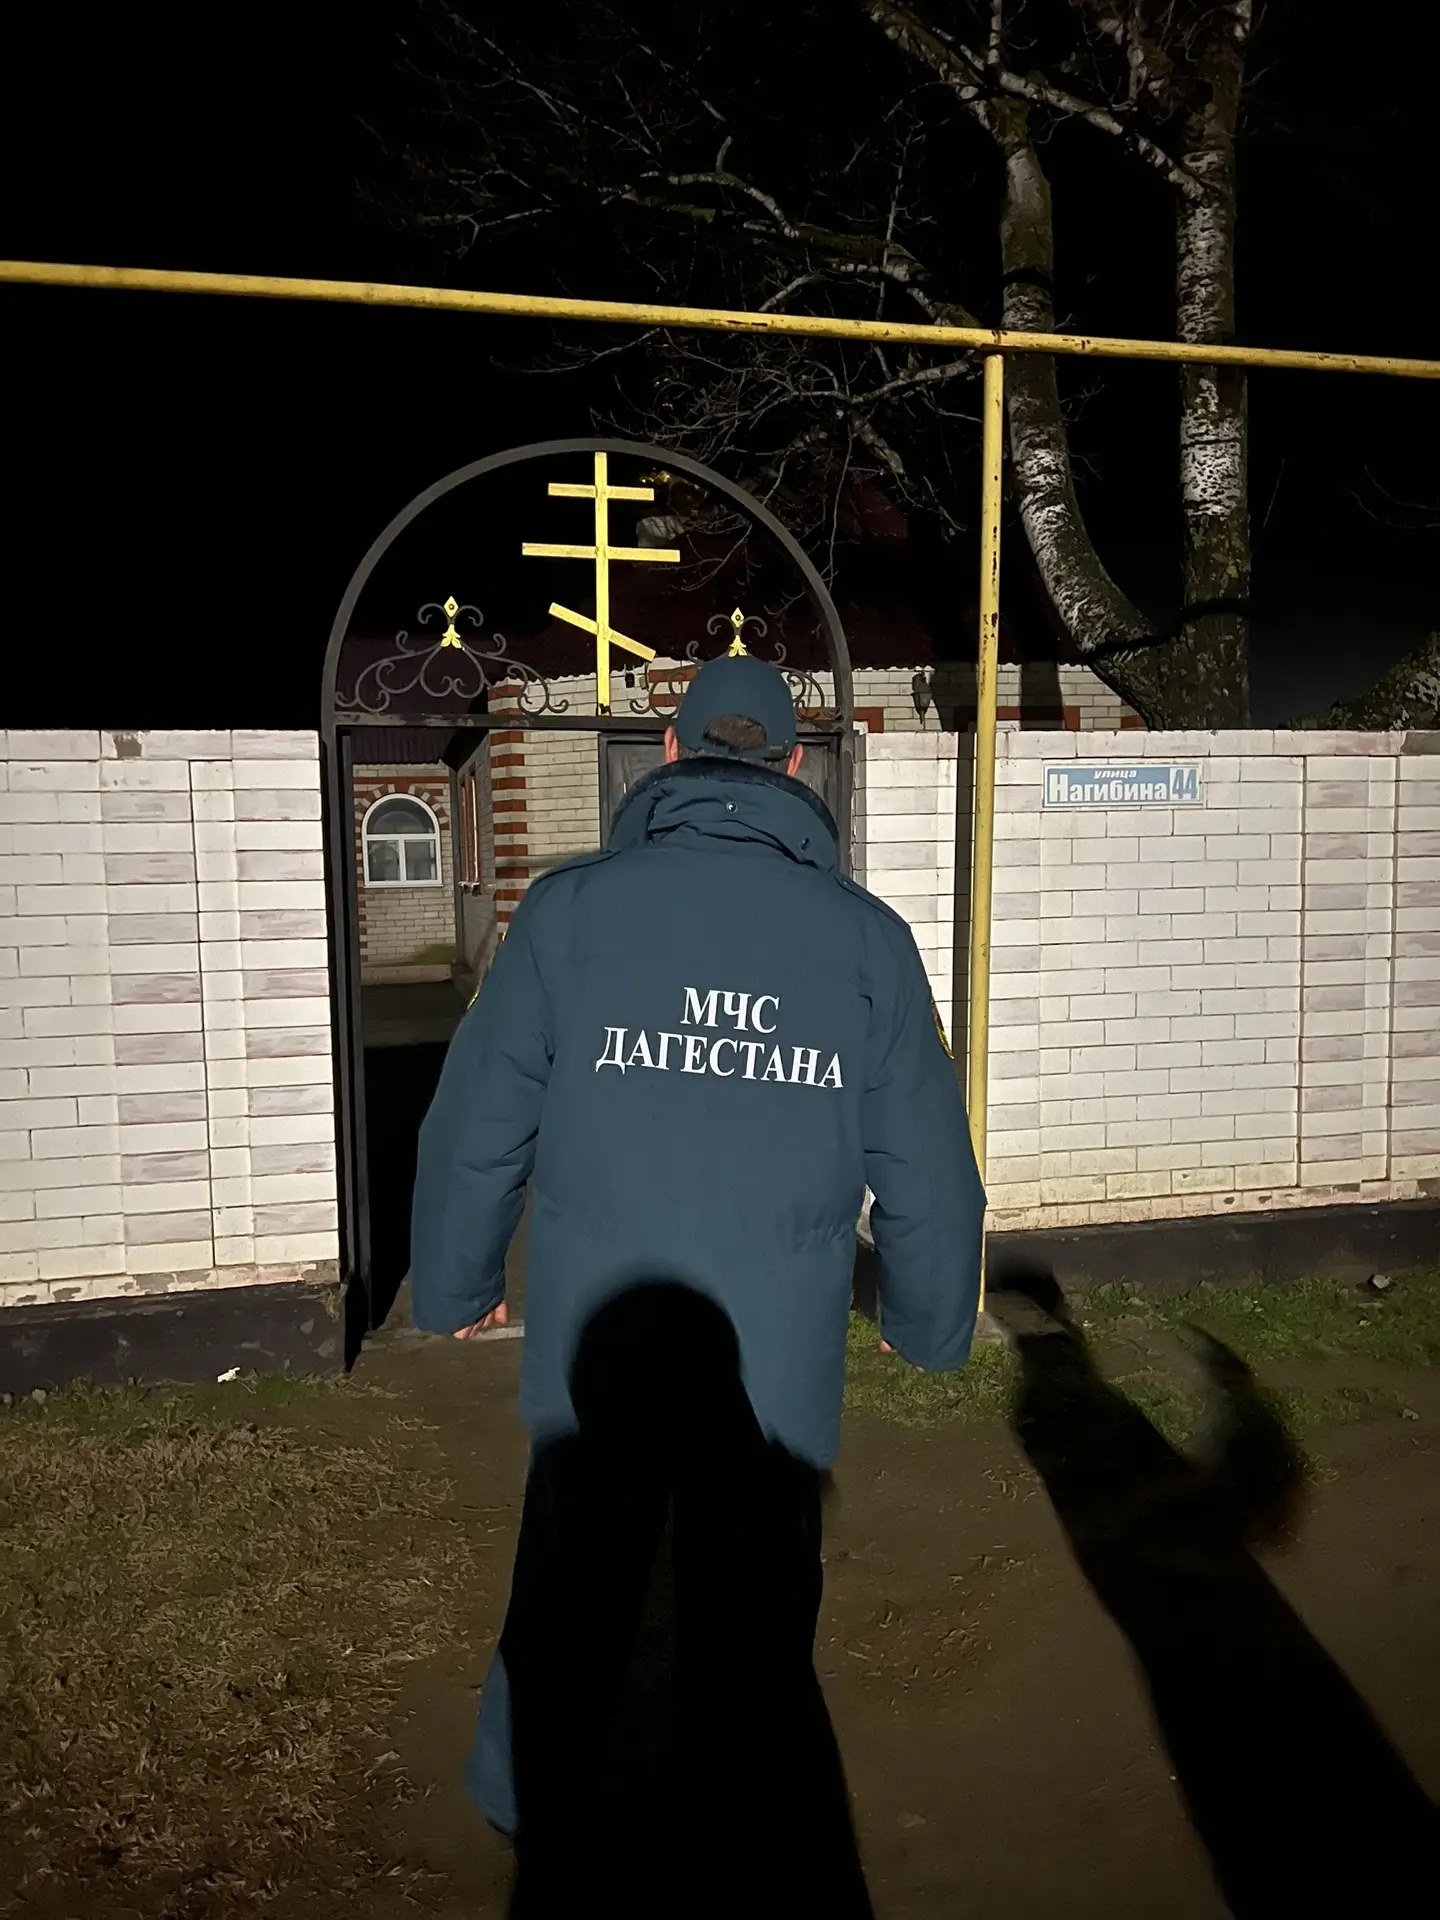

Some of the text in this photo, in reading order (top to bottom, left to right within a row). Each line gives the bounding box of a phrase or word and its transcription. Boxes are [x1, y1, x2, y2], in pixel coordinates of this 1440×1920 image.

[1049, 768, 1198, 802] Нагибина 44
[1093, 769, 1138, 780] улица
[680, 986, 780, 1034] МЧС
[595, 1026, 844, 1089] ДАГЕСТАНА
